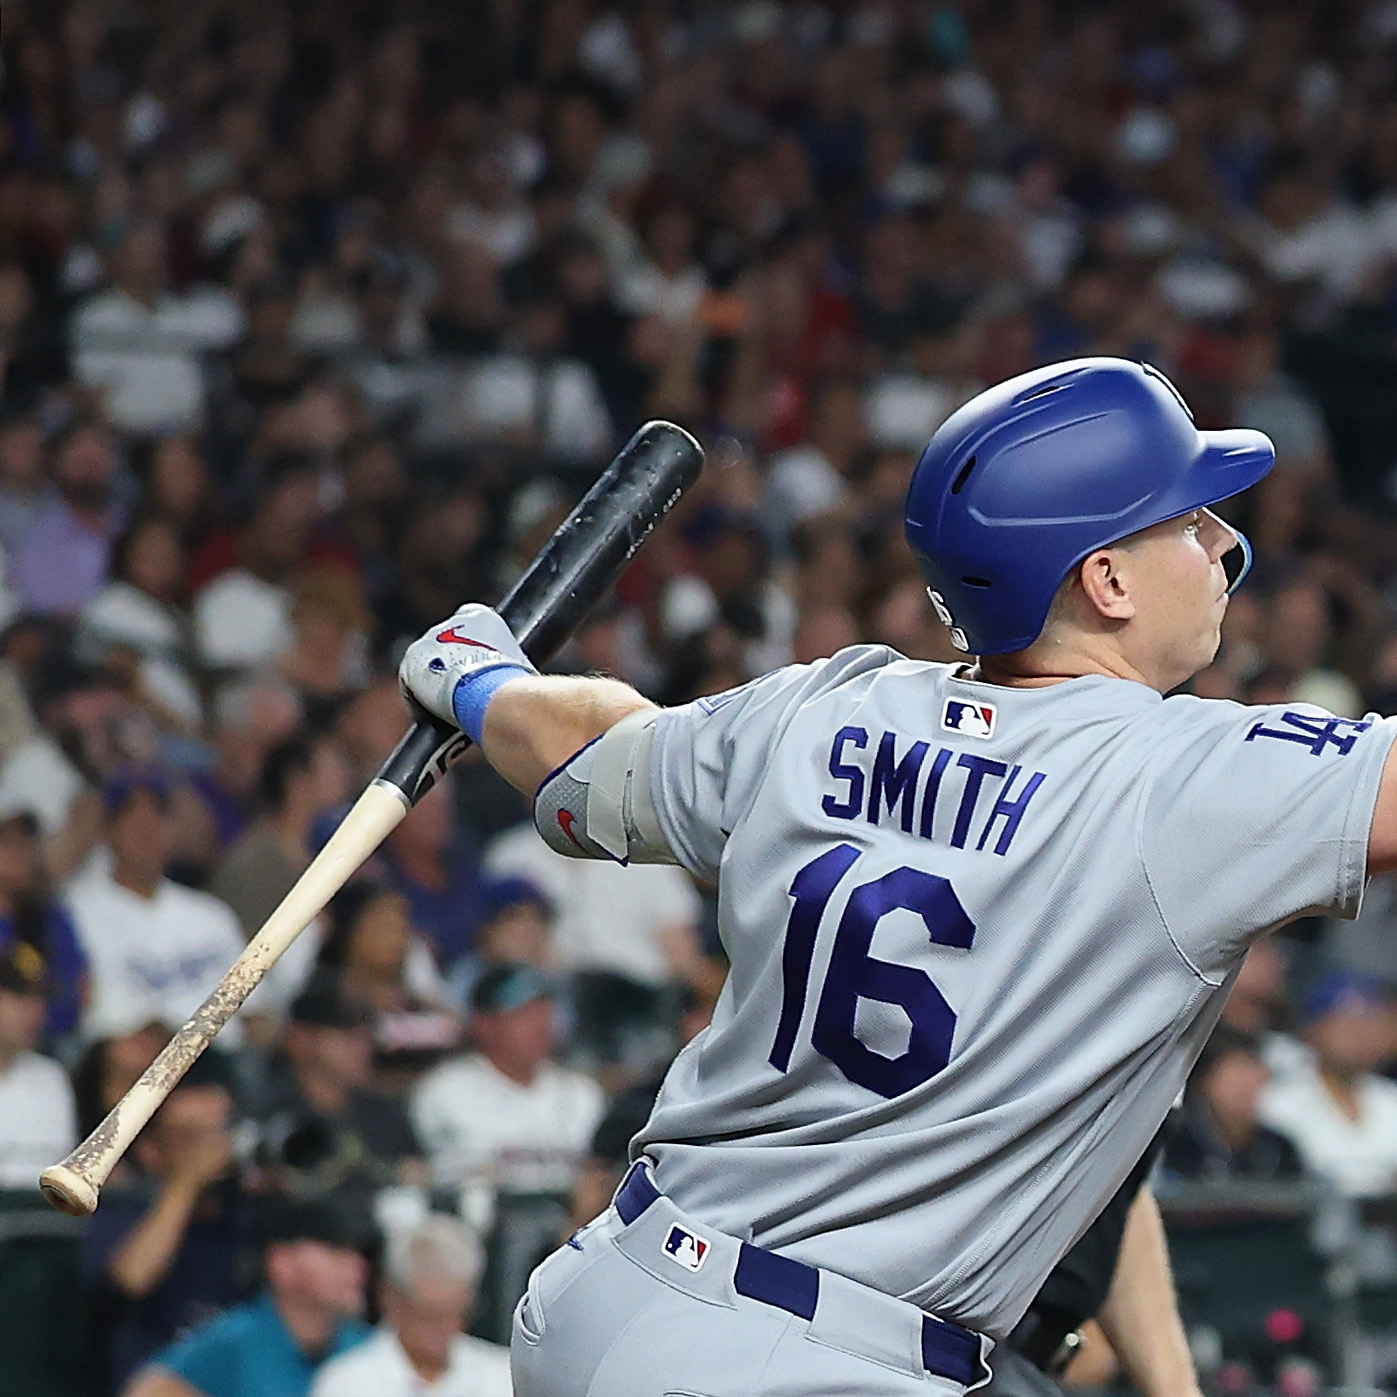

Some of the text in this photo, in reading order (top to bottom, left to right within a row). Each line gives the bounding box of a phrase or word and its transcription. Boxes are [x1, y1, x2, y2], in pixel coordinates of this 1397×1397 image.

[822, 726, 1046, 855] SMITH
[1244, 711, 1373, 757] LA
[768, 843, 976, 1098] 16
